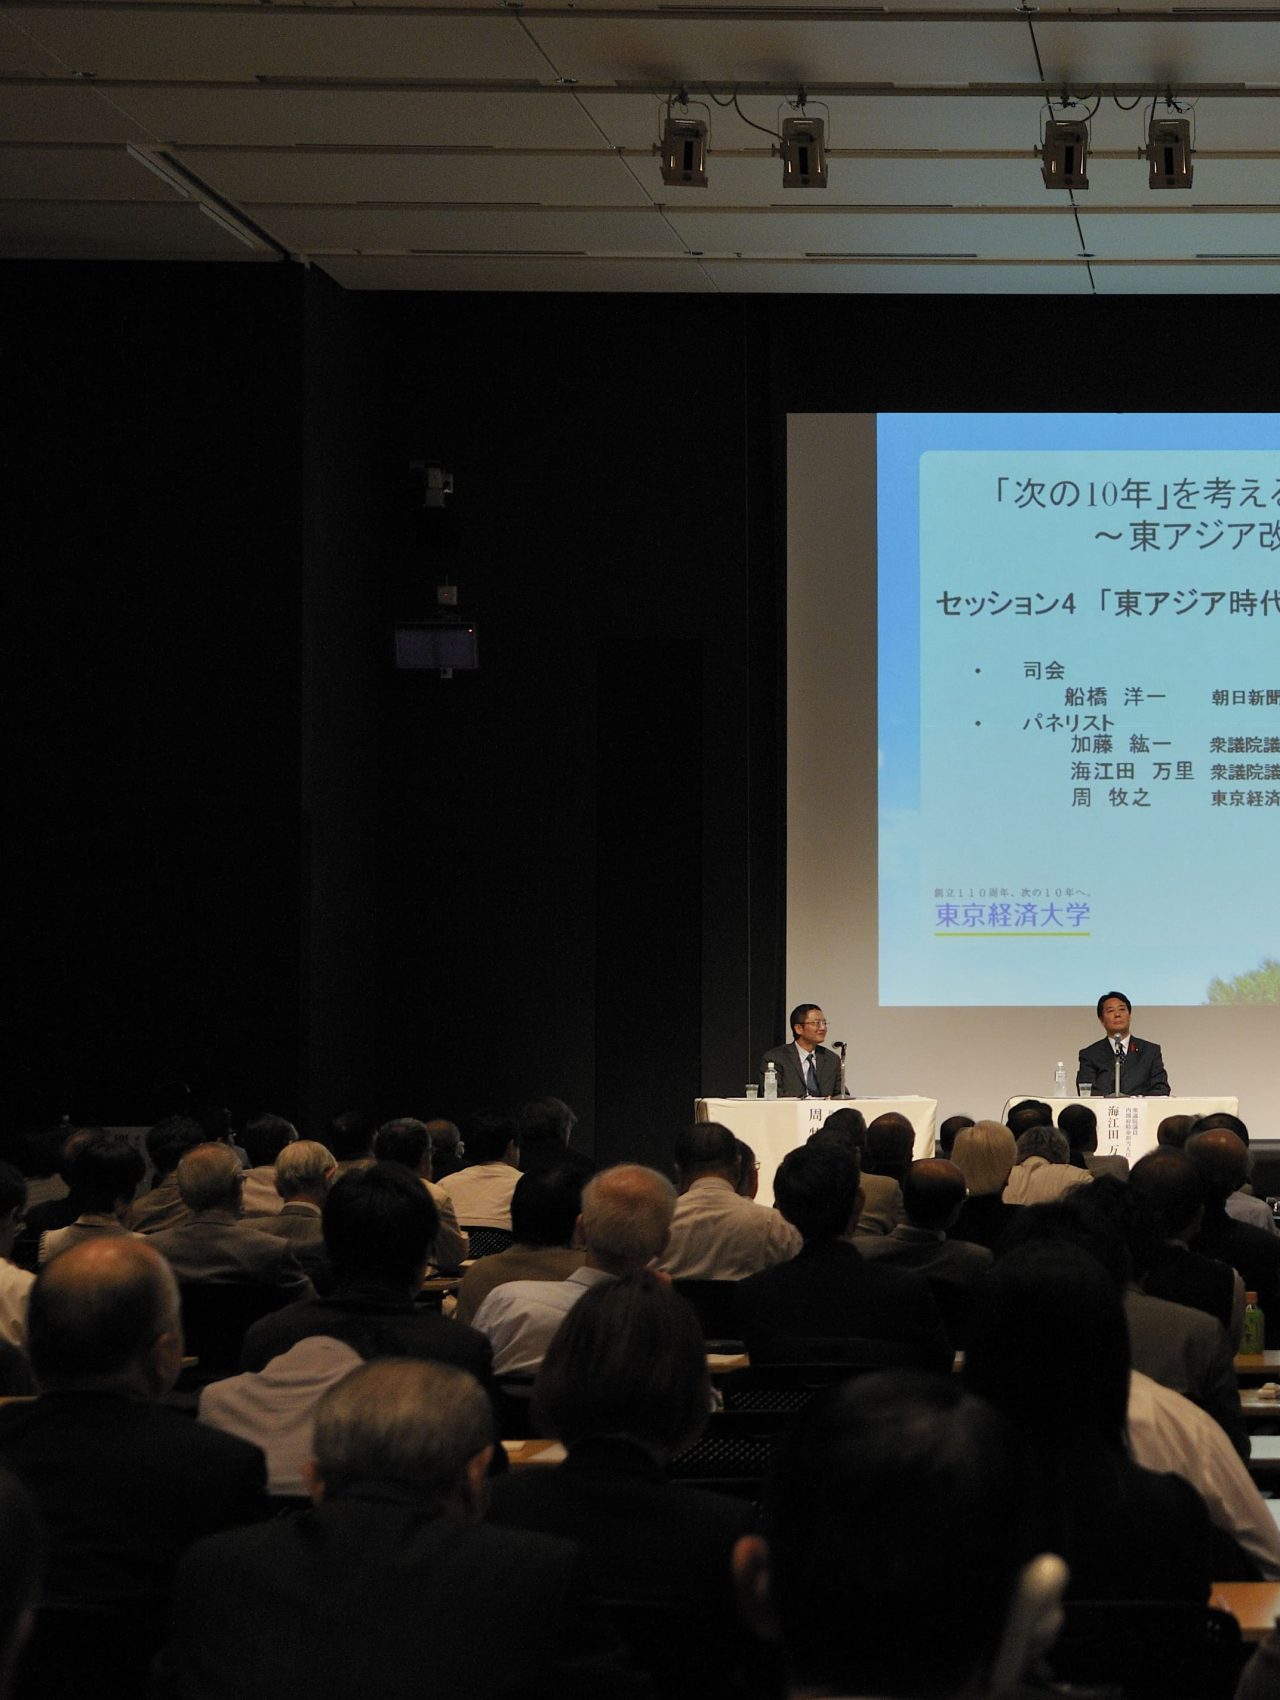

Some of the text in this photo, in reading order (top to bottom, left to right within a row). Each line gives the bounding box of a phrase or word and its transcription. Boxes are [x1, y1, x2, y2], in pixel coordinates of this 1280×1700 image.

[936, 591, 1076, 616] セッション4
[1024, 660, 1065, 680] 司会
[1064, 686, 1107, 706] 船橋
[1124, 687, 1166, 706] 洋一
[1022, 713, 1114, 732] パネリスト
[1071, 733, 1113, 754] 加藤
[1129, 733, 1171, 754] 紘一
[1071, 761, 1134, 781] 海江田
[1153, 761, 1195, 780] 万里
[1072, 788, 1091, 807] 周
[1109, 787, 1151, 807] 牧之
[935, 902, 1091, 928] 東京経済大学
